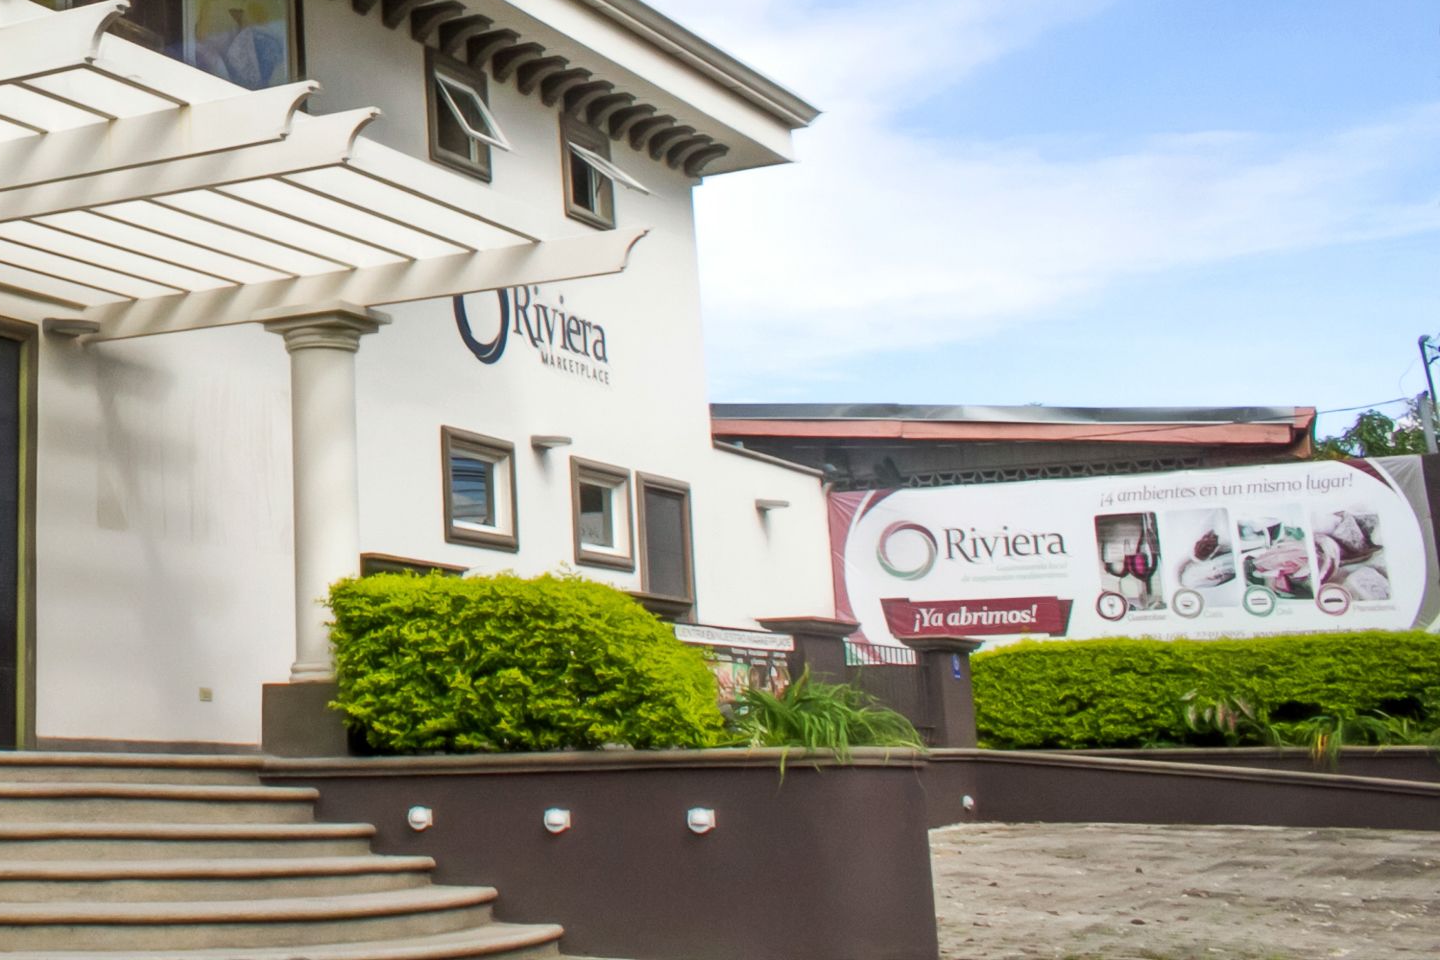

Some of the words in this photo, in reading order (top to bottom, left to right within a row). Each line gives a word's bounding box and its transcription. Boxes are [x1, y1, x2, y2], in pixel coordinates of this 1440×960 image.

[513, 284, 608, 364] Riviera
[541, 351, 609, 385] MARKETPLACE
[1117, 485, 1196, 504] ambientes
[1199, 486, 1218, 497] en
[1222, 484, 1243, 496] un
[1247, 476, 1303, 493] mismo
[1306, 473, 1354, 494] lugar!
[942, 525, 1067, 563] Riviera
[914, 607, 944, 633] ¡Ya
[946, 604, 1038, 627] abrimos!
